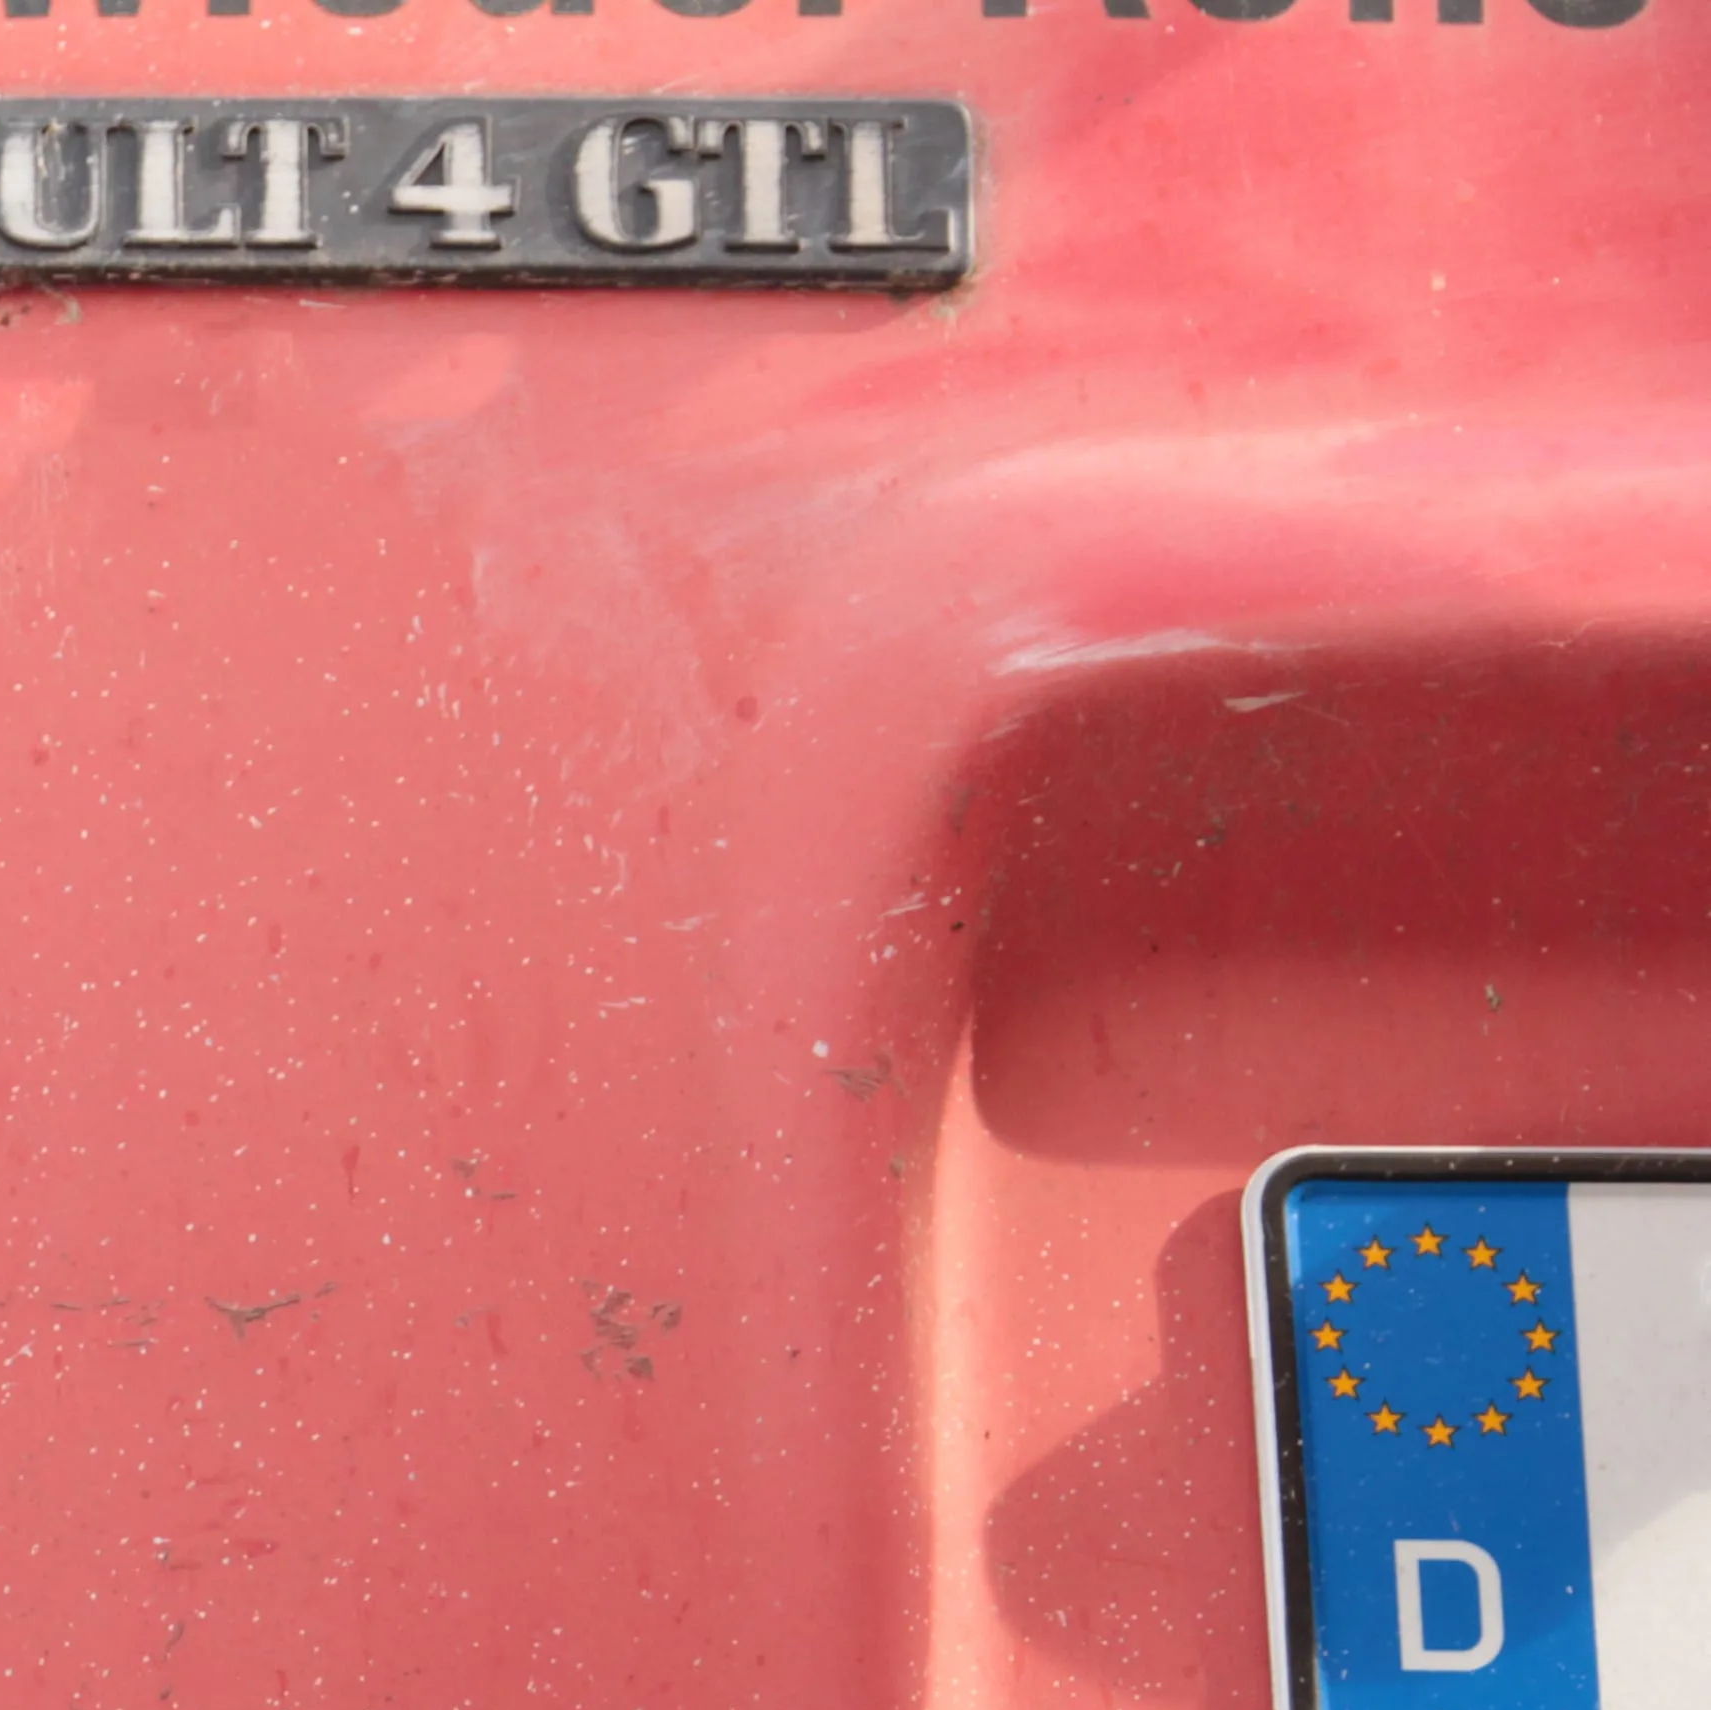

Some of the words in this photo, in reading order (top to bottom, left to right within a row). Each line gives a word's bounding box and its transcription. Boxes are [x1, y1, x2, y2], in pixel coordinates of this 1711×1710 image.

[387, 112, 520, 251] 4
[573, 114, 953, 252] GTL
[1393, 1538, 1505, 1672] D
